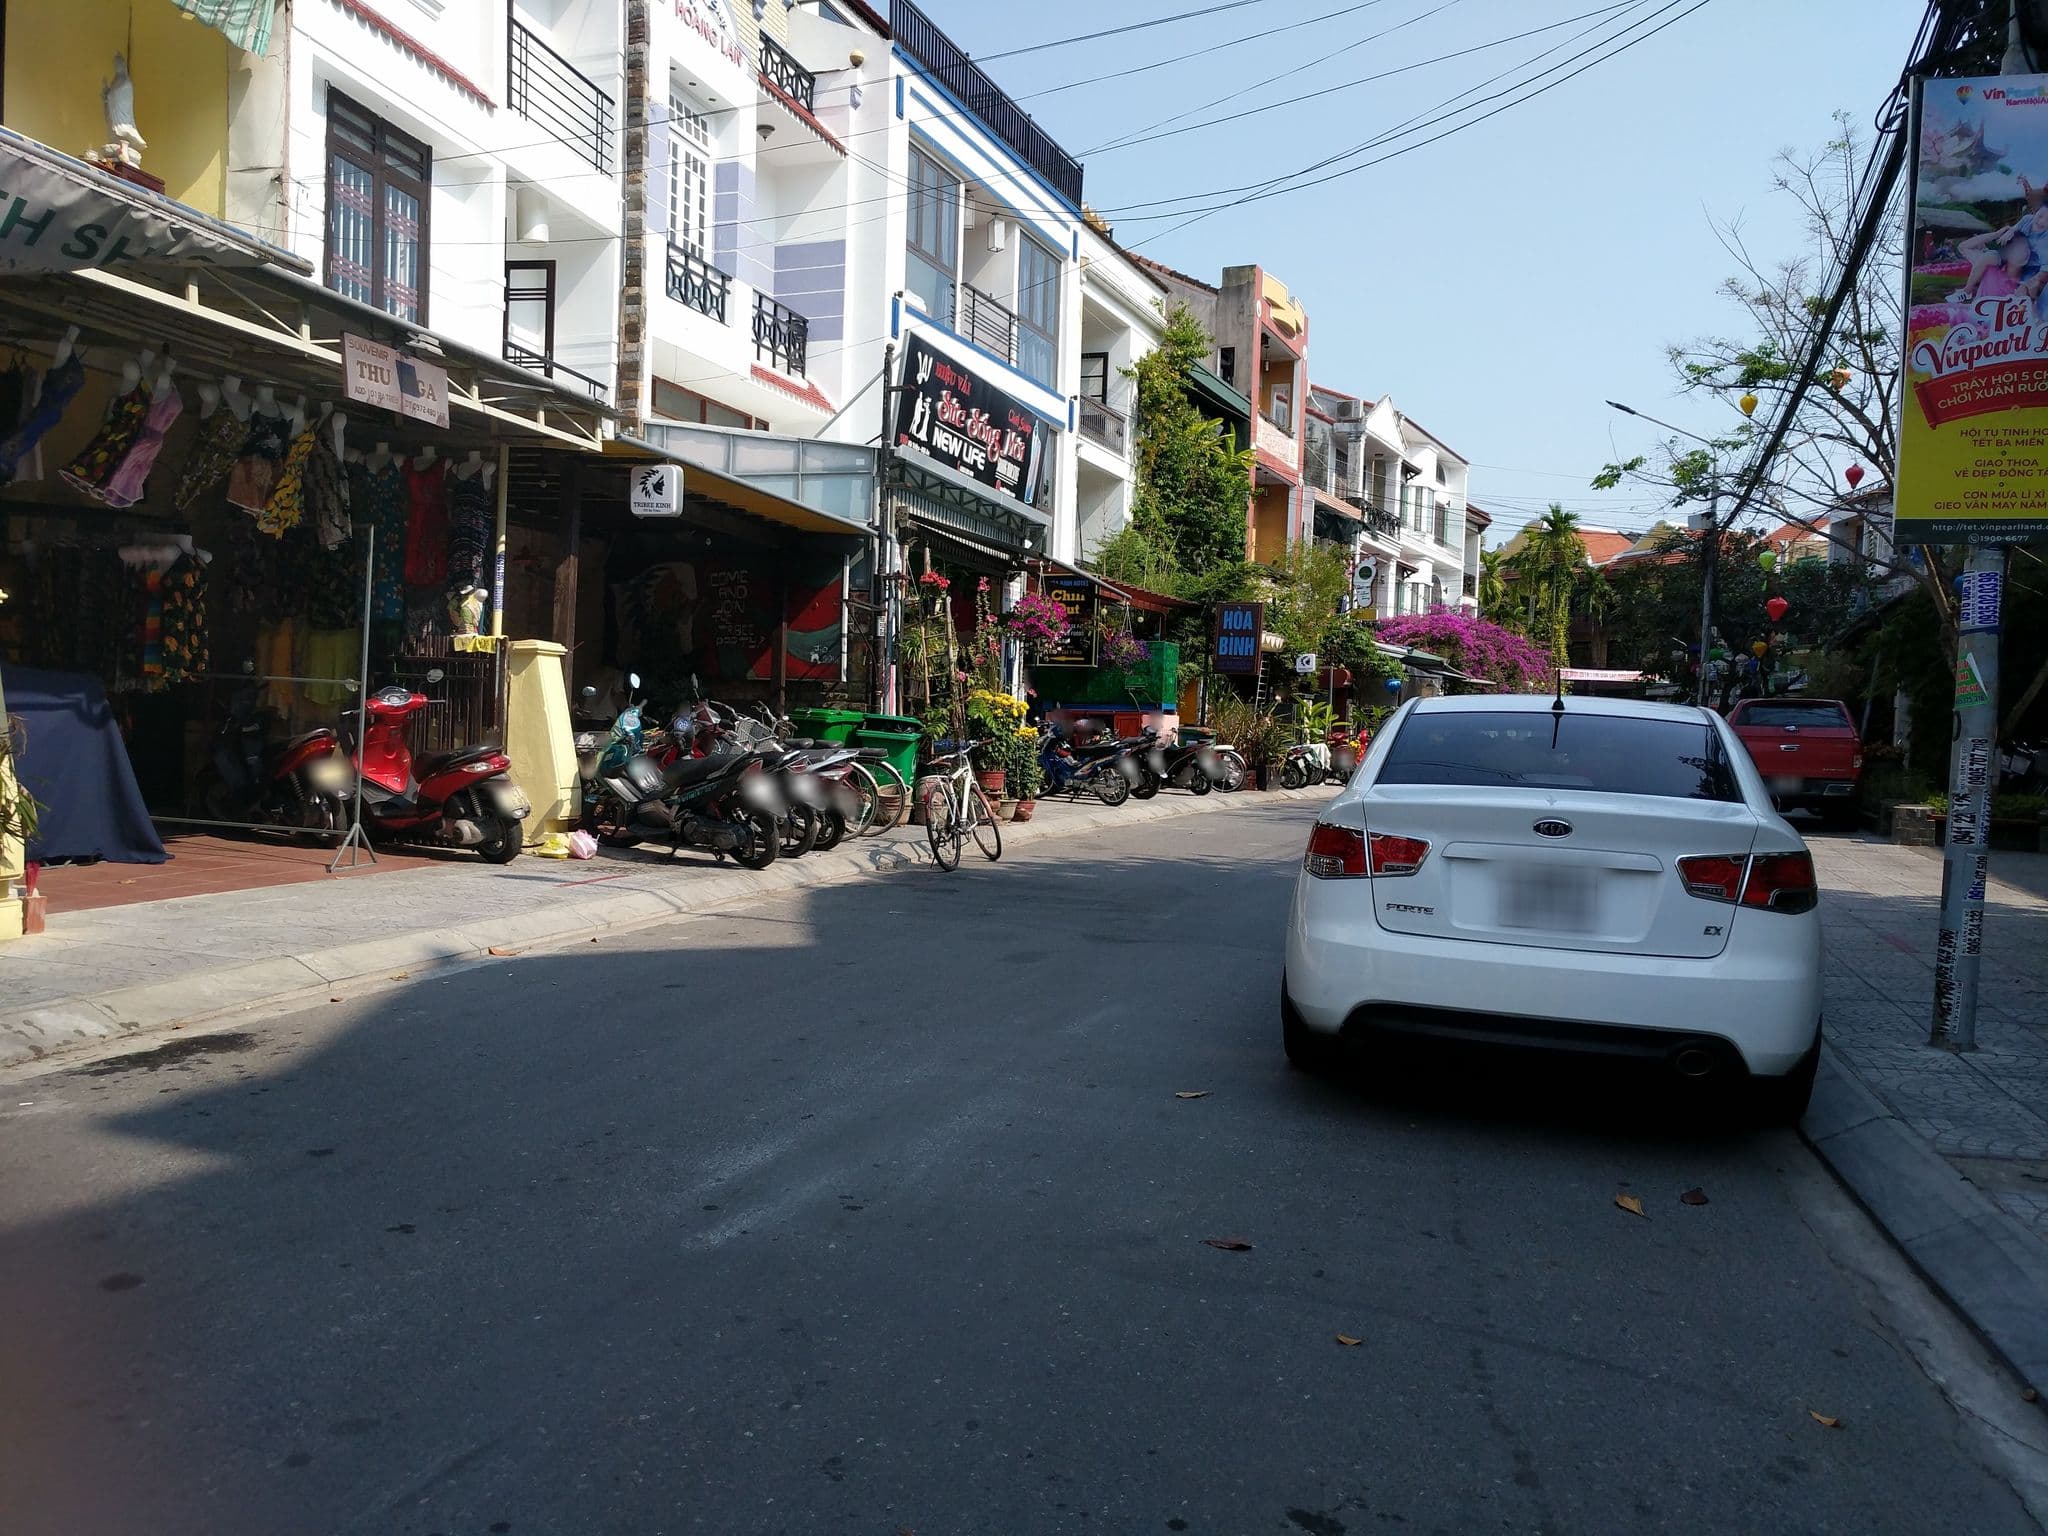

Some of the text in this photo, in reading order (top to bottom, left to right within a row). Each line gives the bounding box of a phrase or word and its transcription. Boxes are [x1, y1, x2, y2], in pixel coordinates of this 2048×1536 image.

[1975, 298, 2028, 332] Tết
[1915, 326, 2031, 374] Vinpearl
[356, 360, 391, 386] THU
[2021, 371, 2030, 381] 5
[932, 426, 963, 457] NEW
[962, 442, 987, 471] LIFE
[1995, 439, 2012, 447] BA
[1974, 459, 2039, 468] GIAO THOA
[1934, 501, 1962, 510] GIEO
[1992, 501, 2017, 509] MAY
[1223, 606, 1253, 630] HÒA
[1218, 632, 1255, 656] BÌNH
[1540, 823, 1565, 835] KIA
[1386, 903, 1434, 915] FORTE
[1704, 925, 1723, 936] EX
